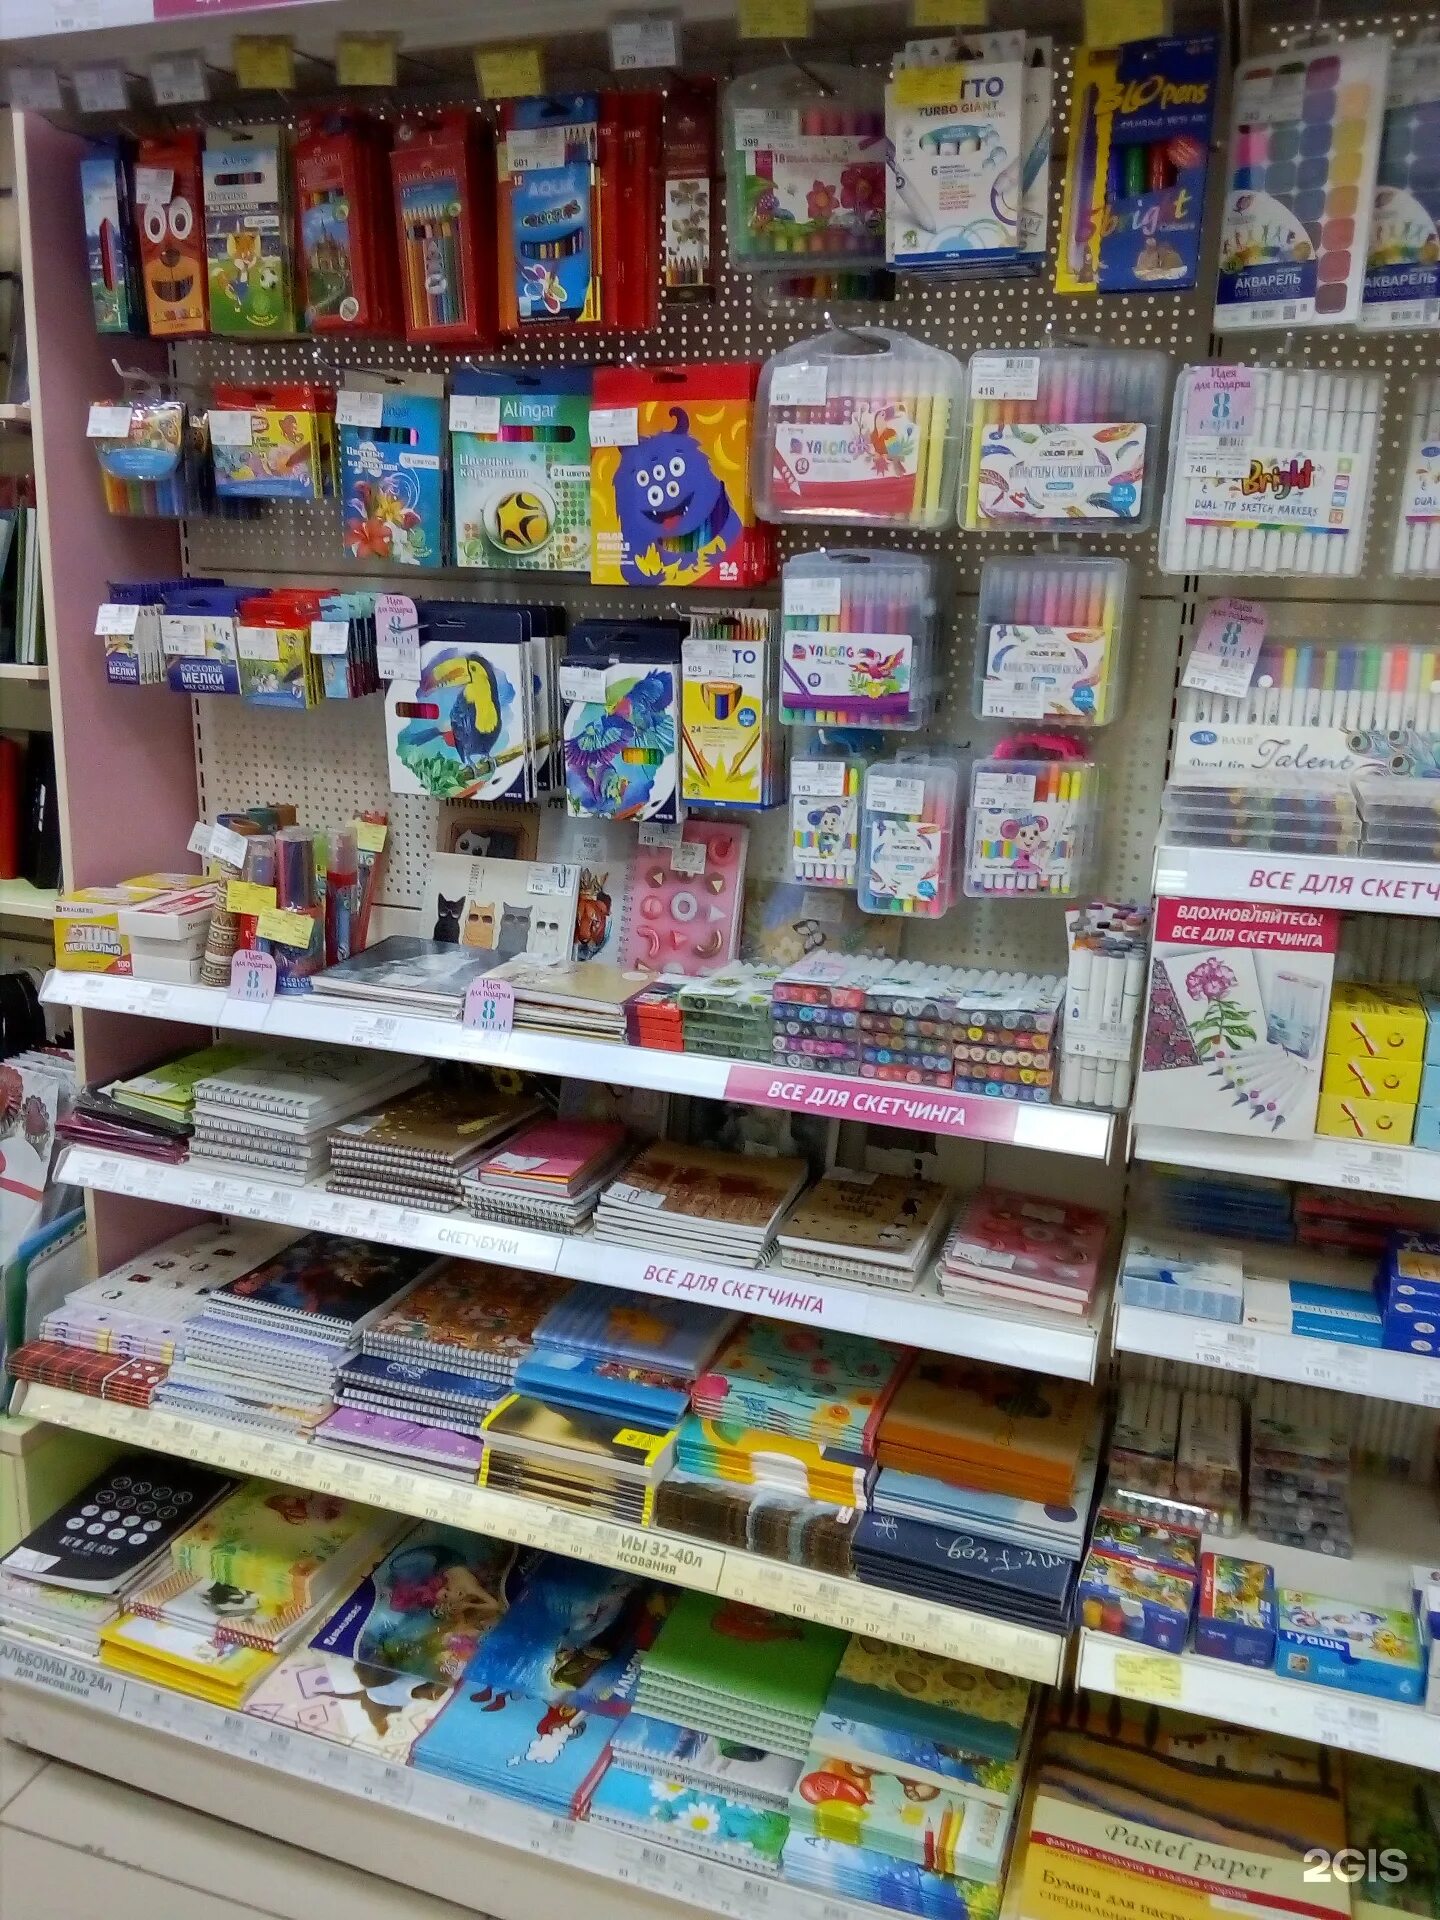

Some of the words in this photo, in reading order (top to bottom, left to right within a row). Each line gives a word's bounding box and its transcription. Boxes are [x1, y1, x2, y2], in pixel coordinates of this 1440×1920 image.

[919, 106, 959, 117] TURBO
[961, 101, 998, 115] GIANT
[742, 138, 760, 147] 399
[513, 158, 529, 168] 601
[774, 153, 786, 165] 18
[931, 166, 938, 176] 6
[1235, 272, 1302, 288] АКВАРЕЛЬ
[1364, 272, 1437, 287] АКВАРЕЛЬ
[1210, 367, 1237, 378] Идея
[978, 387, 995, 396] 418
[1194, 381, 1211, 390] для
[1213, 380, 1251, 389] подарка
[503, 401, 557, 421] Alingar
[1212, 392, 1231, 418] 8
[806, 440, 858, 456] YALONG
[553, 470, 565, 478] 24
[1189, 465, 1208, 474] 746
[1241, 458, 1313, 500] Bright
[1414, 496, 1437, 506] DUAL
[1239, 502, 1275, 513] SKETCH
[1277, 505, 1318, 517] MARKERS
[719, 561, 738, 576] 24
[808, 644, 855, 657] YALONG
[109, 667, 137, 677] МЕЛКИ
[180, 663, 223, 674] ВОСКОВЫЕ
[181, 674, 225, 685] МЕЛКИ
[184, 684, 203, 692] WAX
[989, 705, 1004, 713] 314
[690, 725, 701, 734] 24
[1251, 738, 1355, 771] Talent
[1249, 869, 1297, 891] ВСЕ
[1299, 873, 1354, 896] ДЛЯ
[1176, 904, 1324, 928] ВДОХНОВЛЯЙТЕСЬ!
[1171, 925, 1200, 939] ВСЕ
[1200, 927, 1235, 943] ДЛЯ
[1237, 929, 1323, 948] СКЕТЧИНГА
[244, 952, 263, 961] Идея
[117, 960, 131, 969] 100
[482, 979, 501, 990] Идея
[483, 991, 511, 1000] подарка
[482, 1000, 496, 1020] 8
[767, 1080, 806, 1101] ВСЕ
[805, 1087, 852, 1108] ДЛЯ
[852, 1093, 967, 1126] СКЕТЧИНГА
[437, 1228, 520, 1255] СКЕТЧБУКИ
[643, 1265, 679, 1285] ВСЕ
[677, 1272, 719, 1293] ДЛЯ
[721, 1279, 825, 1314] СКЕТЧИНГА
[650, 1538, 702, 1569] 32-40л
[617, 1550, 677, 1576] исования
[792, 1603, 807, 1613] 101
[1287, 1631, 1346, 1651] гуашь
[0, 1645, 67, 1679] АЛЬБОМЫ
[14, 1665, 35, 1679] для
[35, 1673, 91, 1698] рисования
[1104, 1823, 1193, 1862] Pastel
[1194, 1848, 1273, 1880] paper
[1042, 1869, 1103, 1900] Бумага
[1105, 1892, 1137, 1911] для
